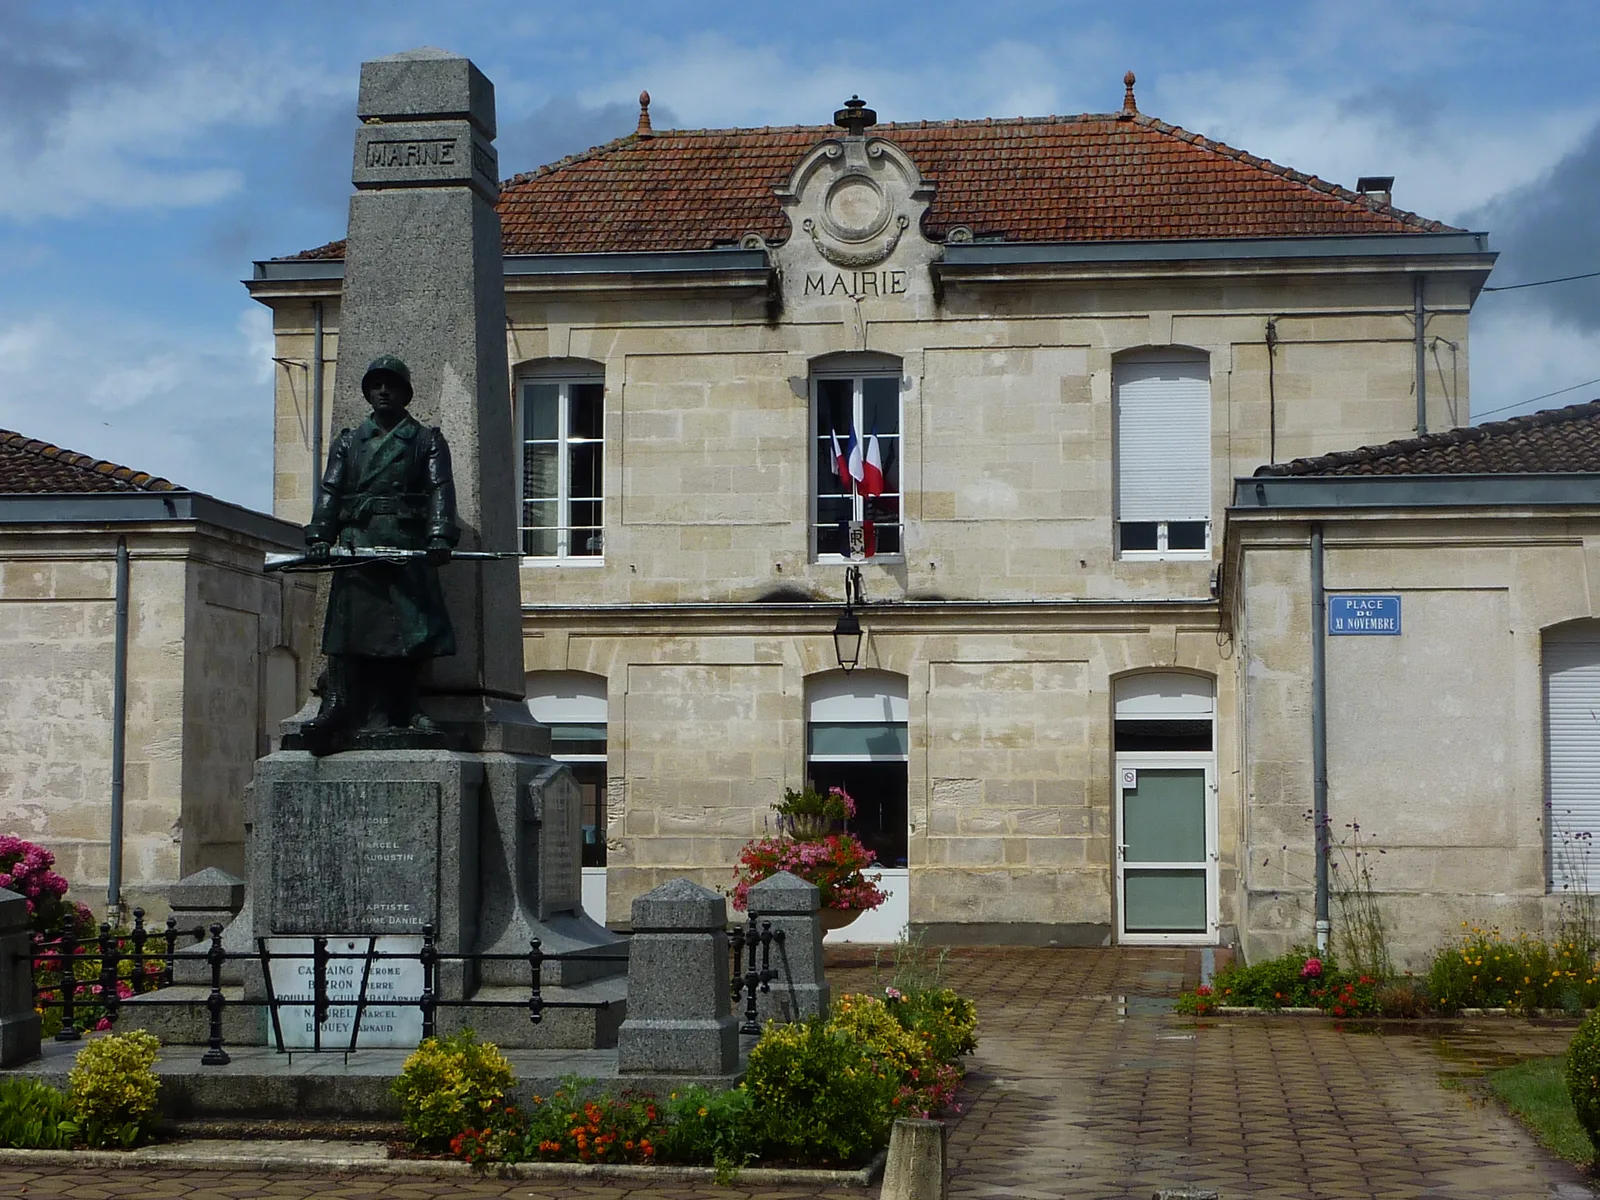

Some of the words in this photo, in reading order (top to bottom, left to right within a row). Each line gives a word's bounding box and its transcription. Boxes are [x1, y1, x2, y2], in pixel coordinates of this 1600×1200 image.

[369, 144, 456, 167] MARNE
[803, 270, 907, 297] MAIRIE
[1346, 600, 1384, 609] PLACE
[1335, 617, 1344, 630] XI
[1347, 617, 1395, 630] NOVEMBRE
[363, 853, 414, 861] AUGUSTIN
[388, 915, 424, 925] DANIEL
[297, 965, 354, 976] CAAING
[307, 979, 353, 990] BRON
[360, 1009, 397, 1018] MARCEL
[359, 1023, 395, 1033] ARNAUD
